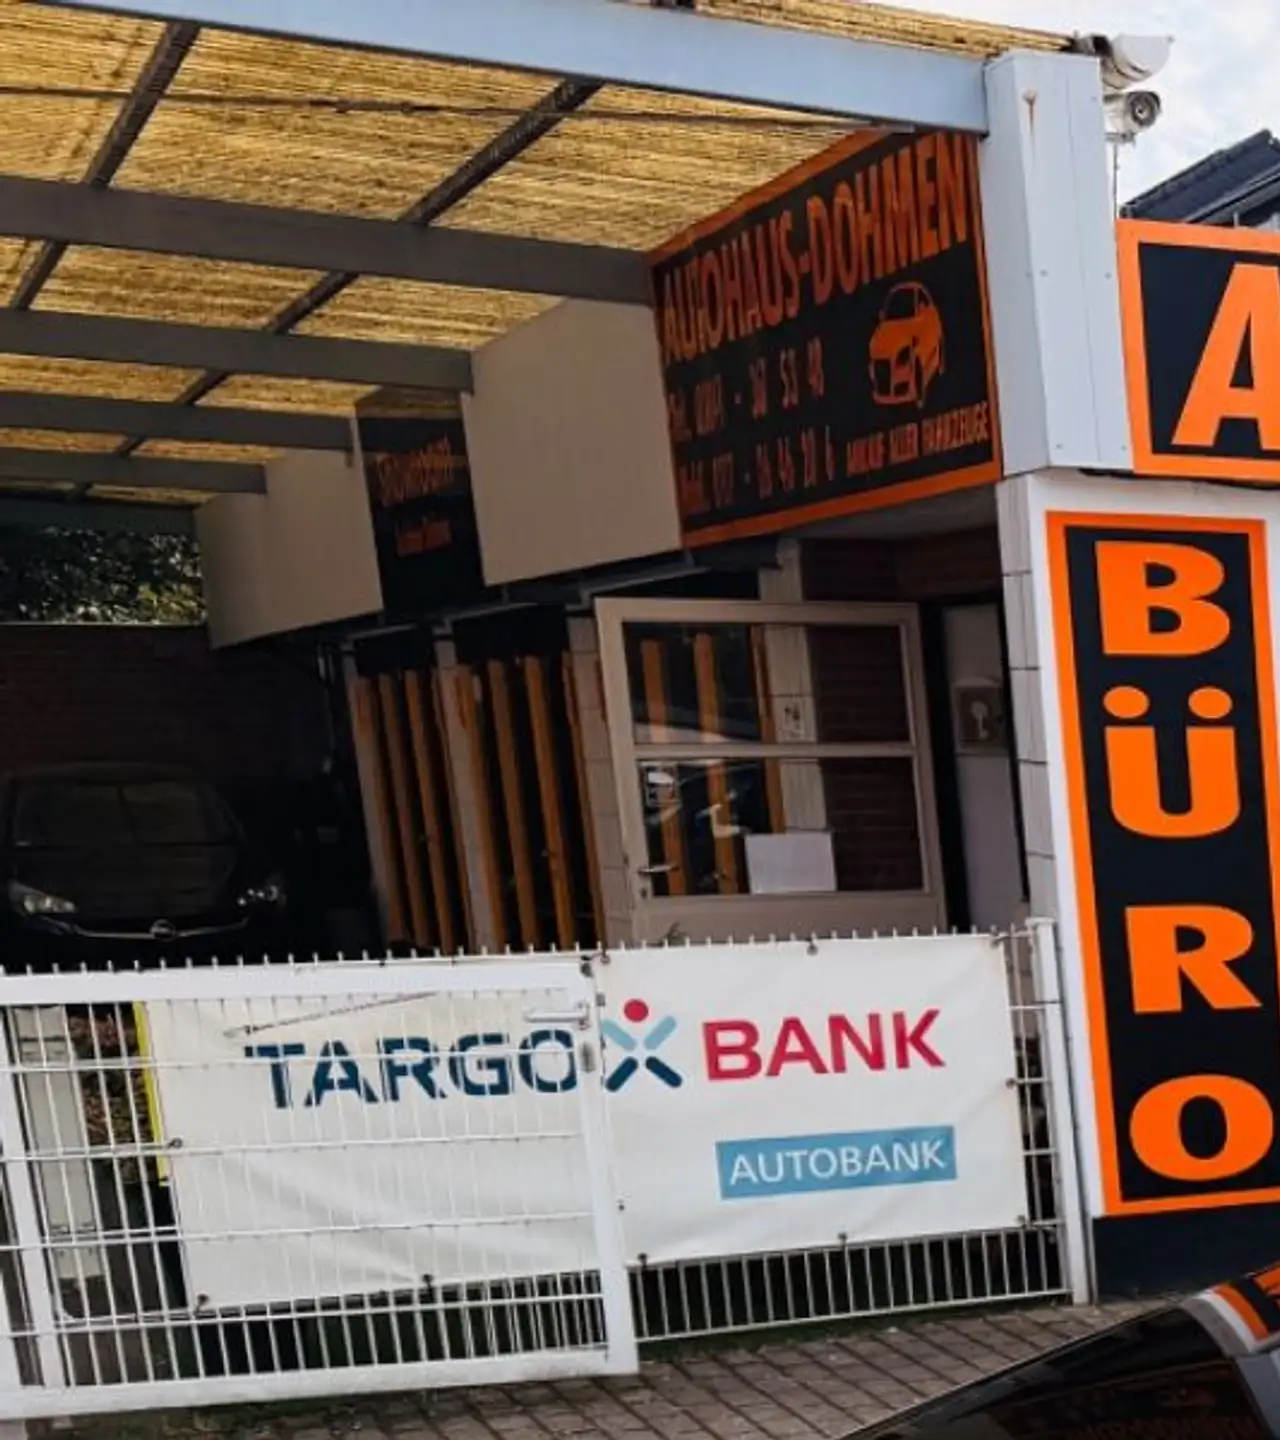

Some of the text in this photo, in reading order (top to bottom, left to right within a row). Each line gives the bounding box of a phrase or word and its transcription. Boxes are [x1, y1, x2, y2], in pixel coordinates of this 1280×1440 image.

[1095, 540, 1274, 1181] BÜRO
[244, 1008, 946, 1109] TARGO BANK
[729, 1137, 948, 1186] AUTOBANK
